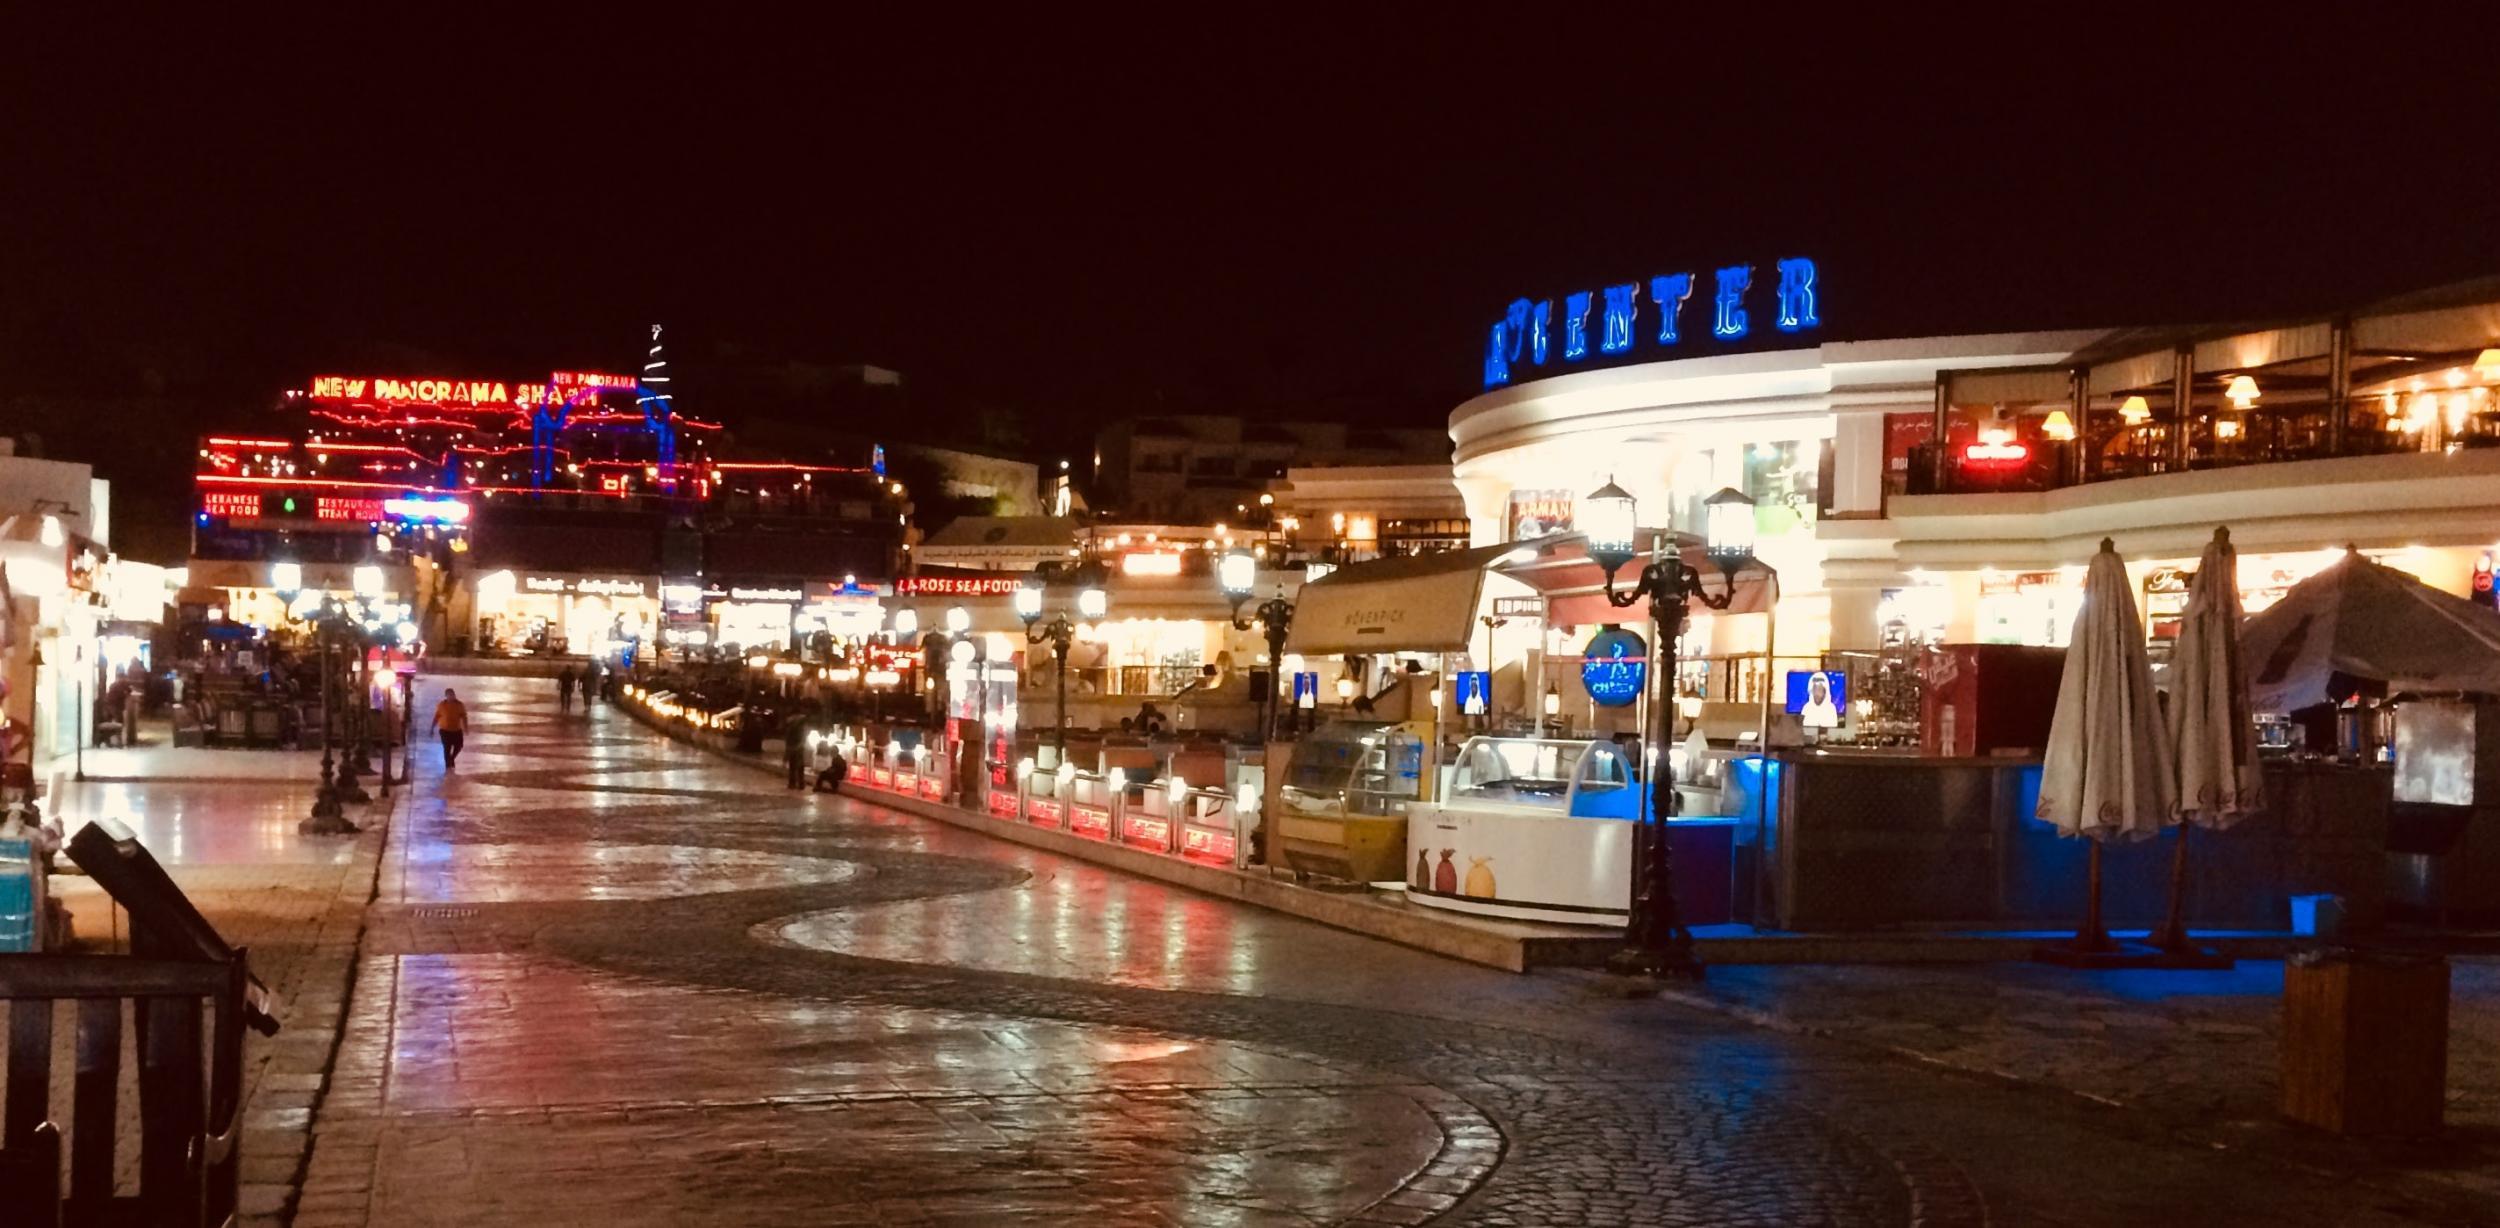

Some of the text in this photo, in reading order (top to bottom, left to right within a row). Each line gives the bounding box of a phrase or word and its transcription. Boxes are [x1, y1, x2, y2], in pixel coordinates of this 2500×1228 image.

[553, 372, 636, 389] NEW PANORAMA
[313, 377, 366, 399] NEW
[375, 379, 508, 404] PANORAMA
[205, 493, 259, 505] LEBANESE
[205, 504, 259, 516] SEA FOOD
[318, 508, 349, 519] STEAK
[919, 579, 953, 592] ROSE
